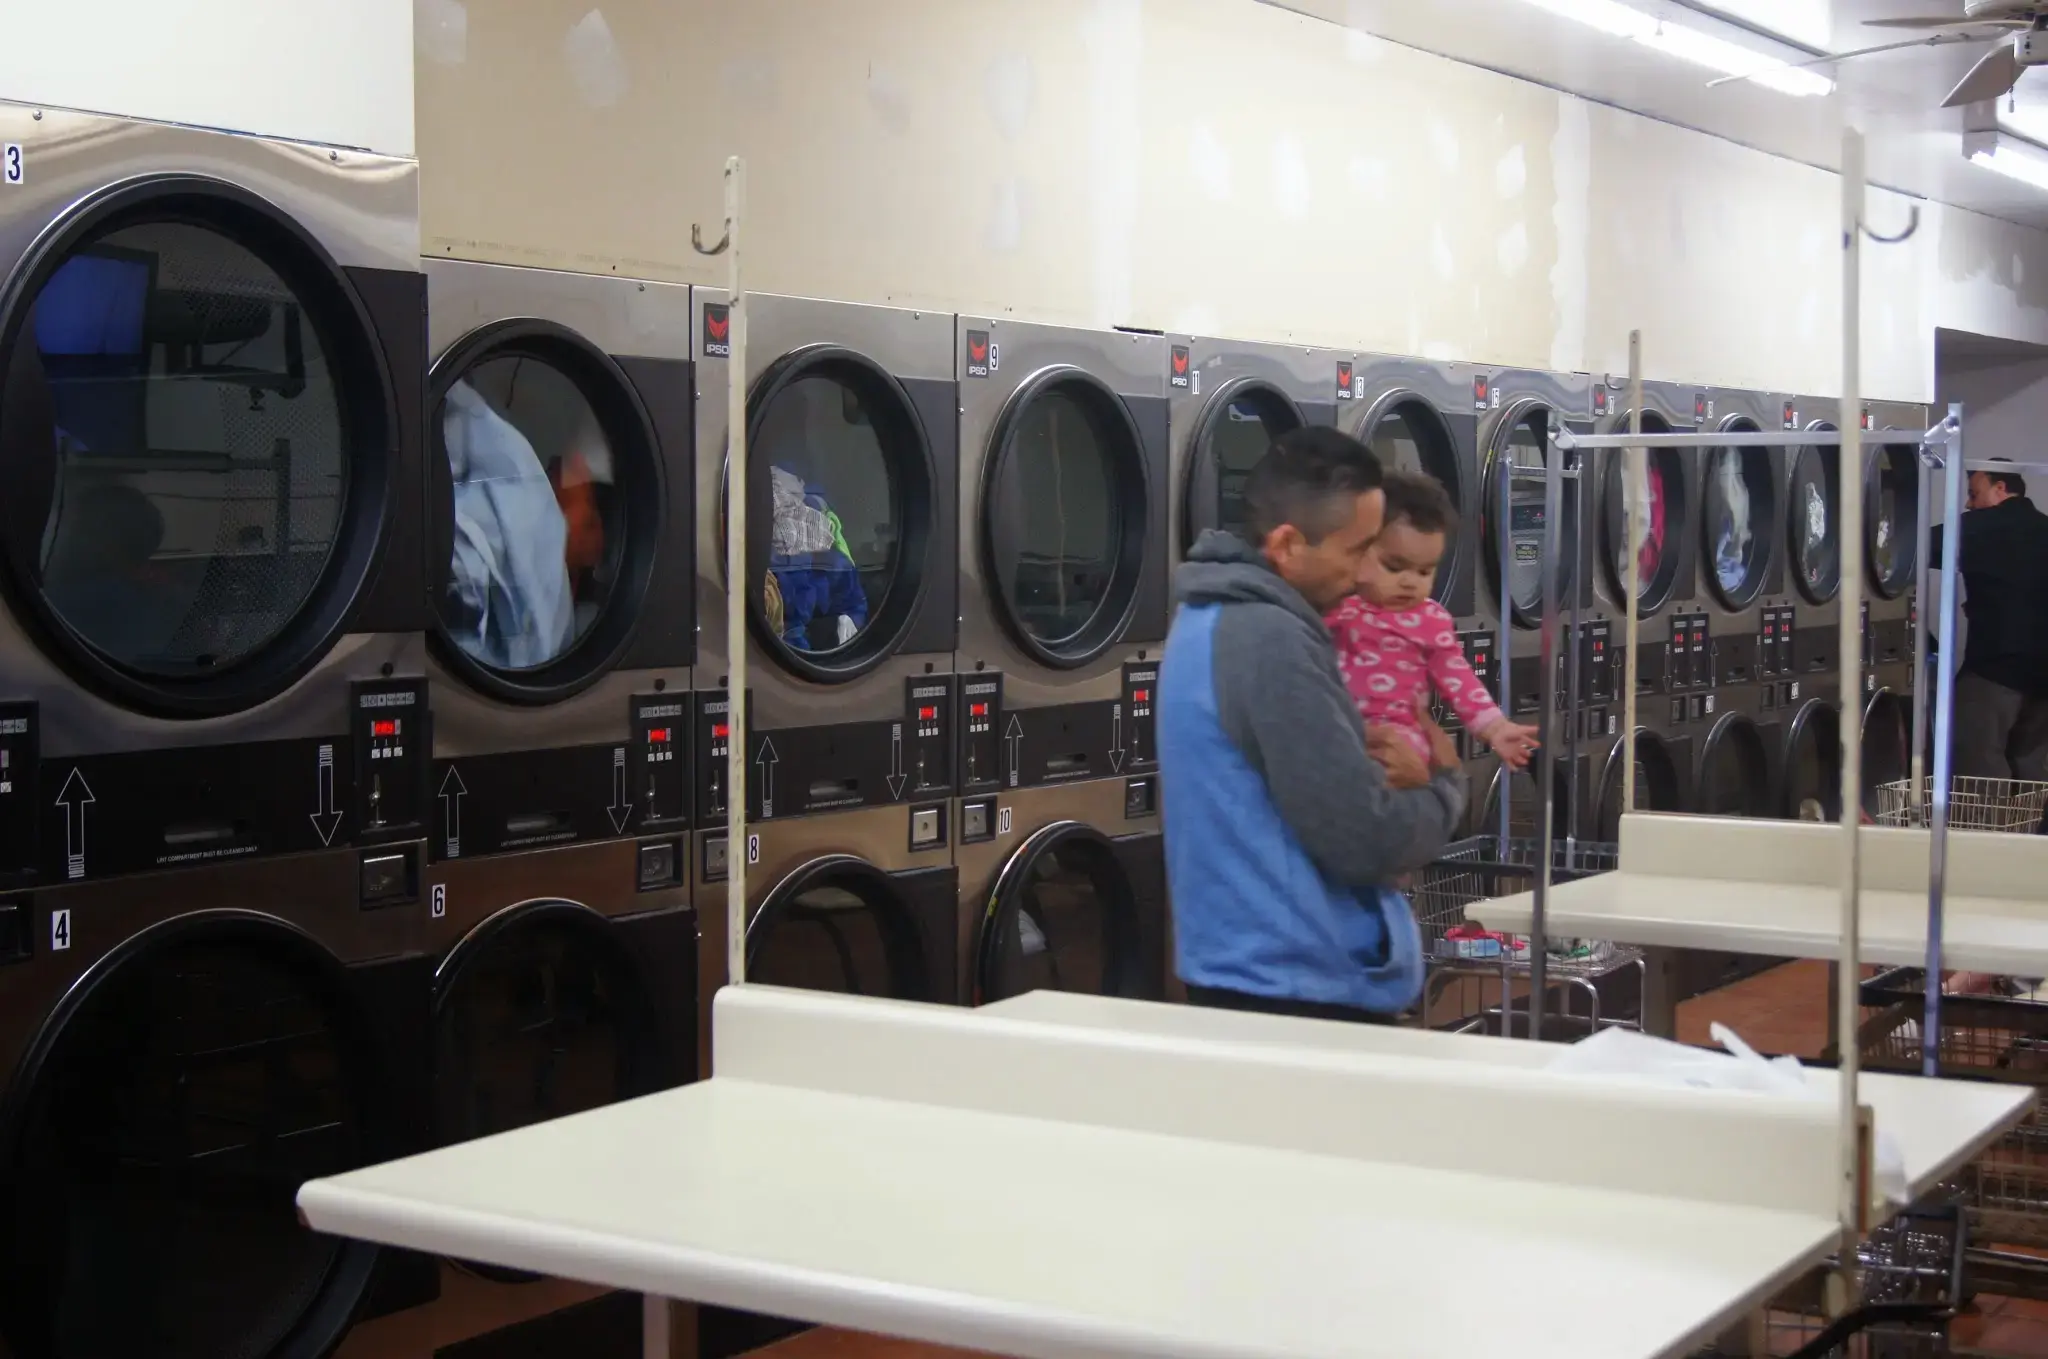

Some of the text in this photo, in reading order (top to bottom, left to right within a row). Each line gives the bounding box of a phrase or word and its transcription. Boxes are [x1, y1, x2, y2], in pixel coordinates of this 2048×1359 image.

[7, 145, 21, 181] 3
[706, 343, 729, 355] IPSO
[991, 345, 998, 368] 9
[968, 365, 987, 376] IPSO
[1172, 376, 1188, 387] IPSO
[1193, 372, 1199, 393] 11
[1000, 809, 1010, 832] 10
[751, 836, 758, 861] 8
[434, 886, 443, 914] 6
[55, 912, 68, 946] 4
